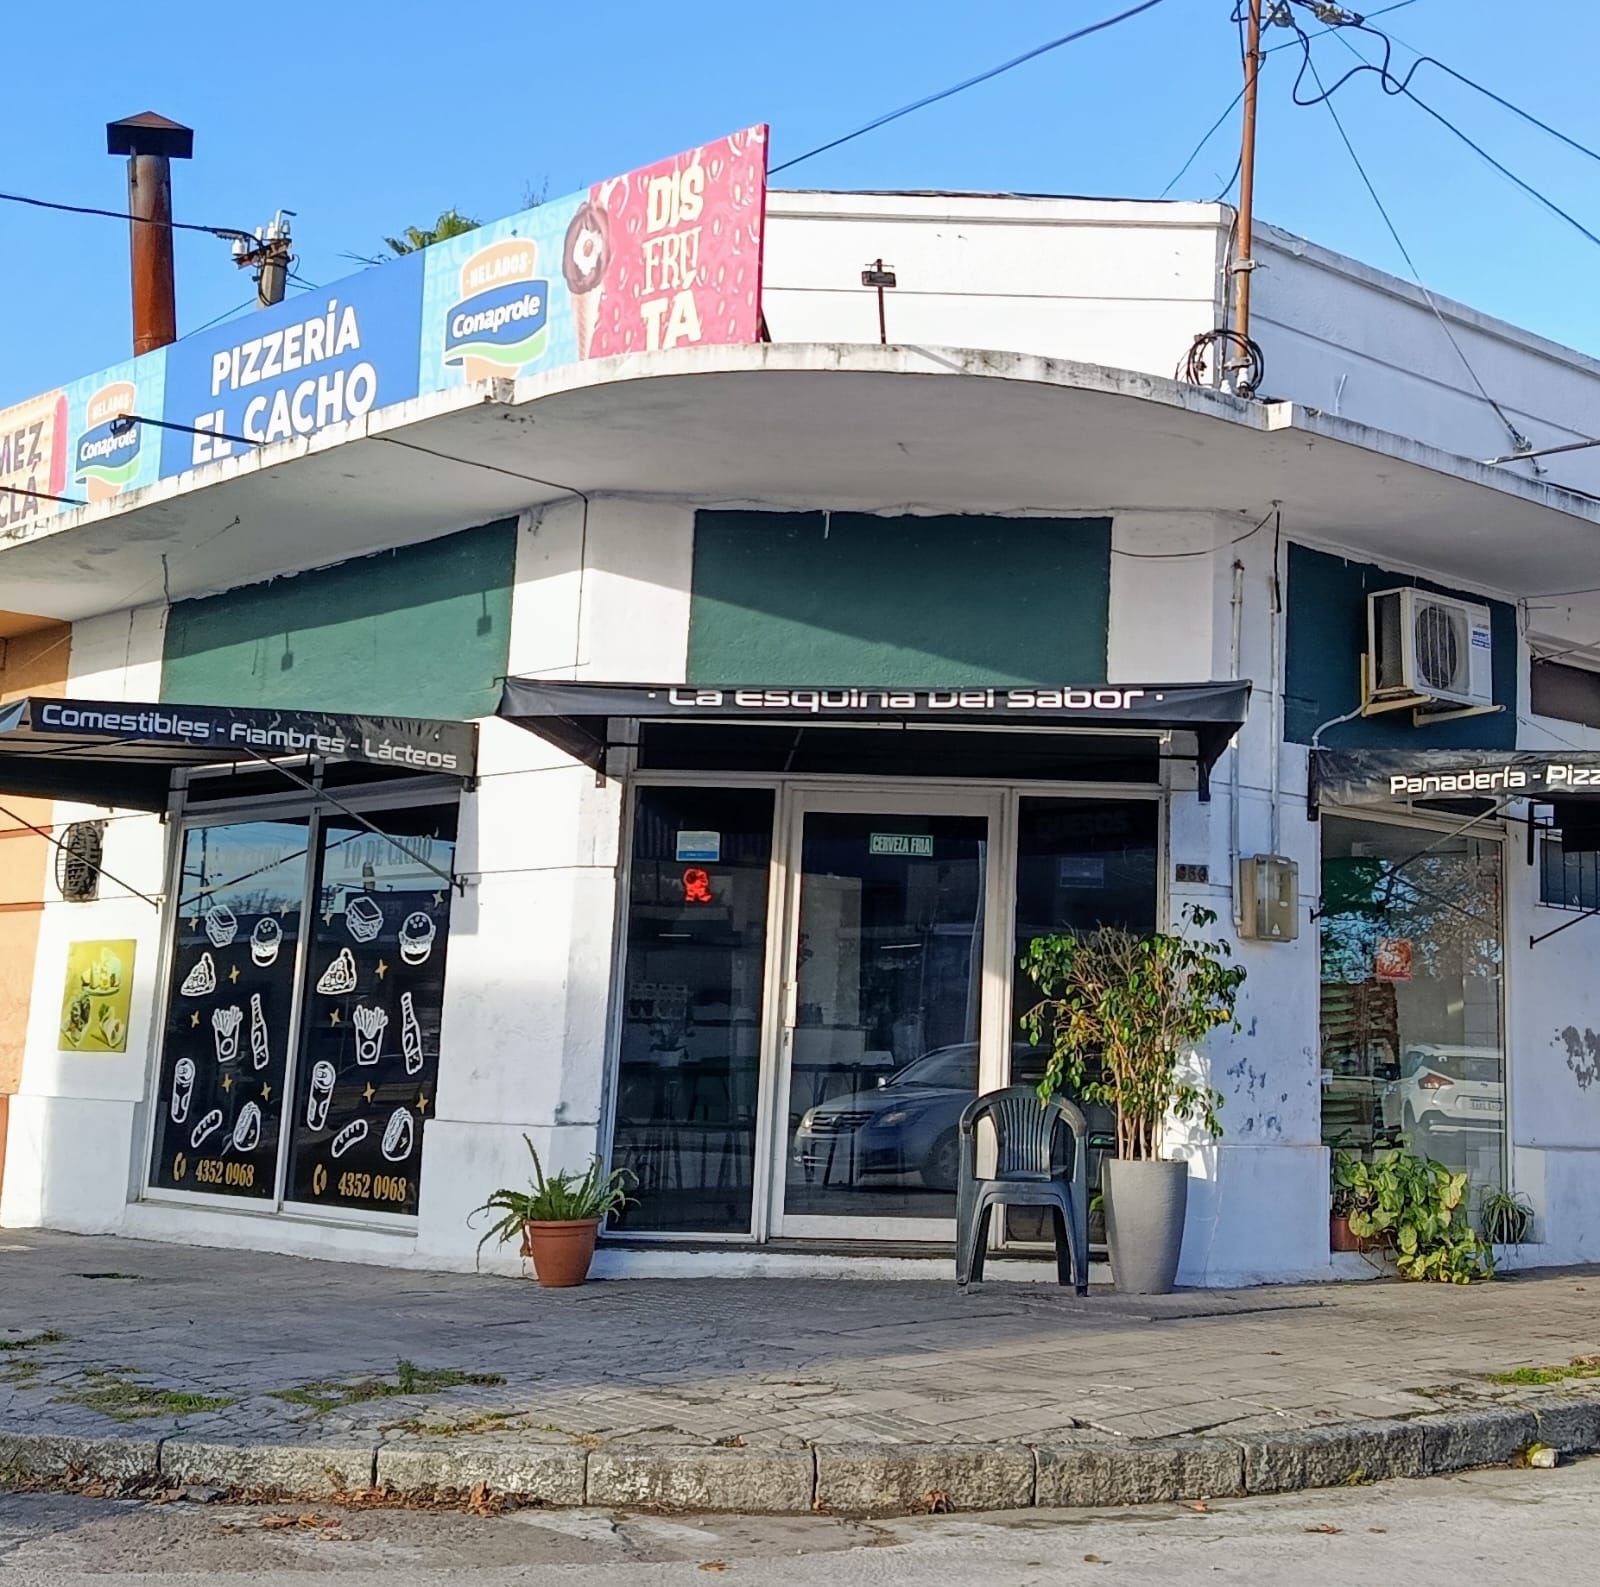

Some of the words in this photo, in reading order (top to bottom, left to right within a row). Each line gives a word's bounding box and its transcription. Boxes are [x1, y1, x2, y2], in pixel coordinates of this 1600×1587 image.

[647, 166, 704, 233] DIS
[470, 252, 529, 288] HELADOS
[641, 226, 702, 296] FRU
[452, 295, 541, 338] Conaprole
[211, 300, 360, 396] PIZZERÍA
[192, 410, 231, 465] EL
[243, 362, 377, 447] CACHO
[669, 687, 722, 706] La
[735, 688, 916, 713] Esquina
[1007, 686, 1144, 710] Sabor
[42, 704, 210, 738] Comestibles
[230, 722, 345, 754] Fiambres
[364, 738, 457, 769] Lácteos
[1389, 765, 1526, 795] Panadería
[872, 835, 909, 853] CERVEZA
[194, 1159, 223, 1184] 4352
[225, 1162, 254, 1187] 0968
[338, 1171, 370, 1199] 4352
[373, 1174, 407, 1202] 0968
